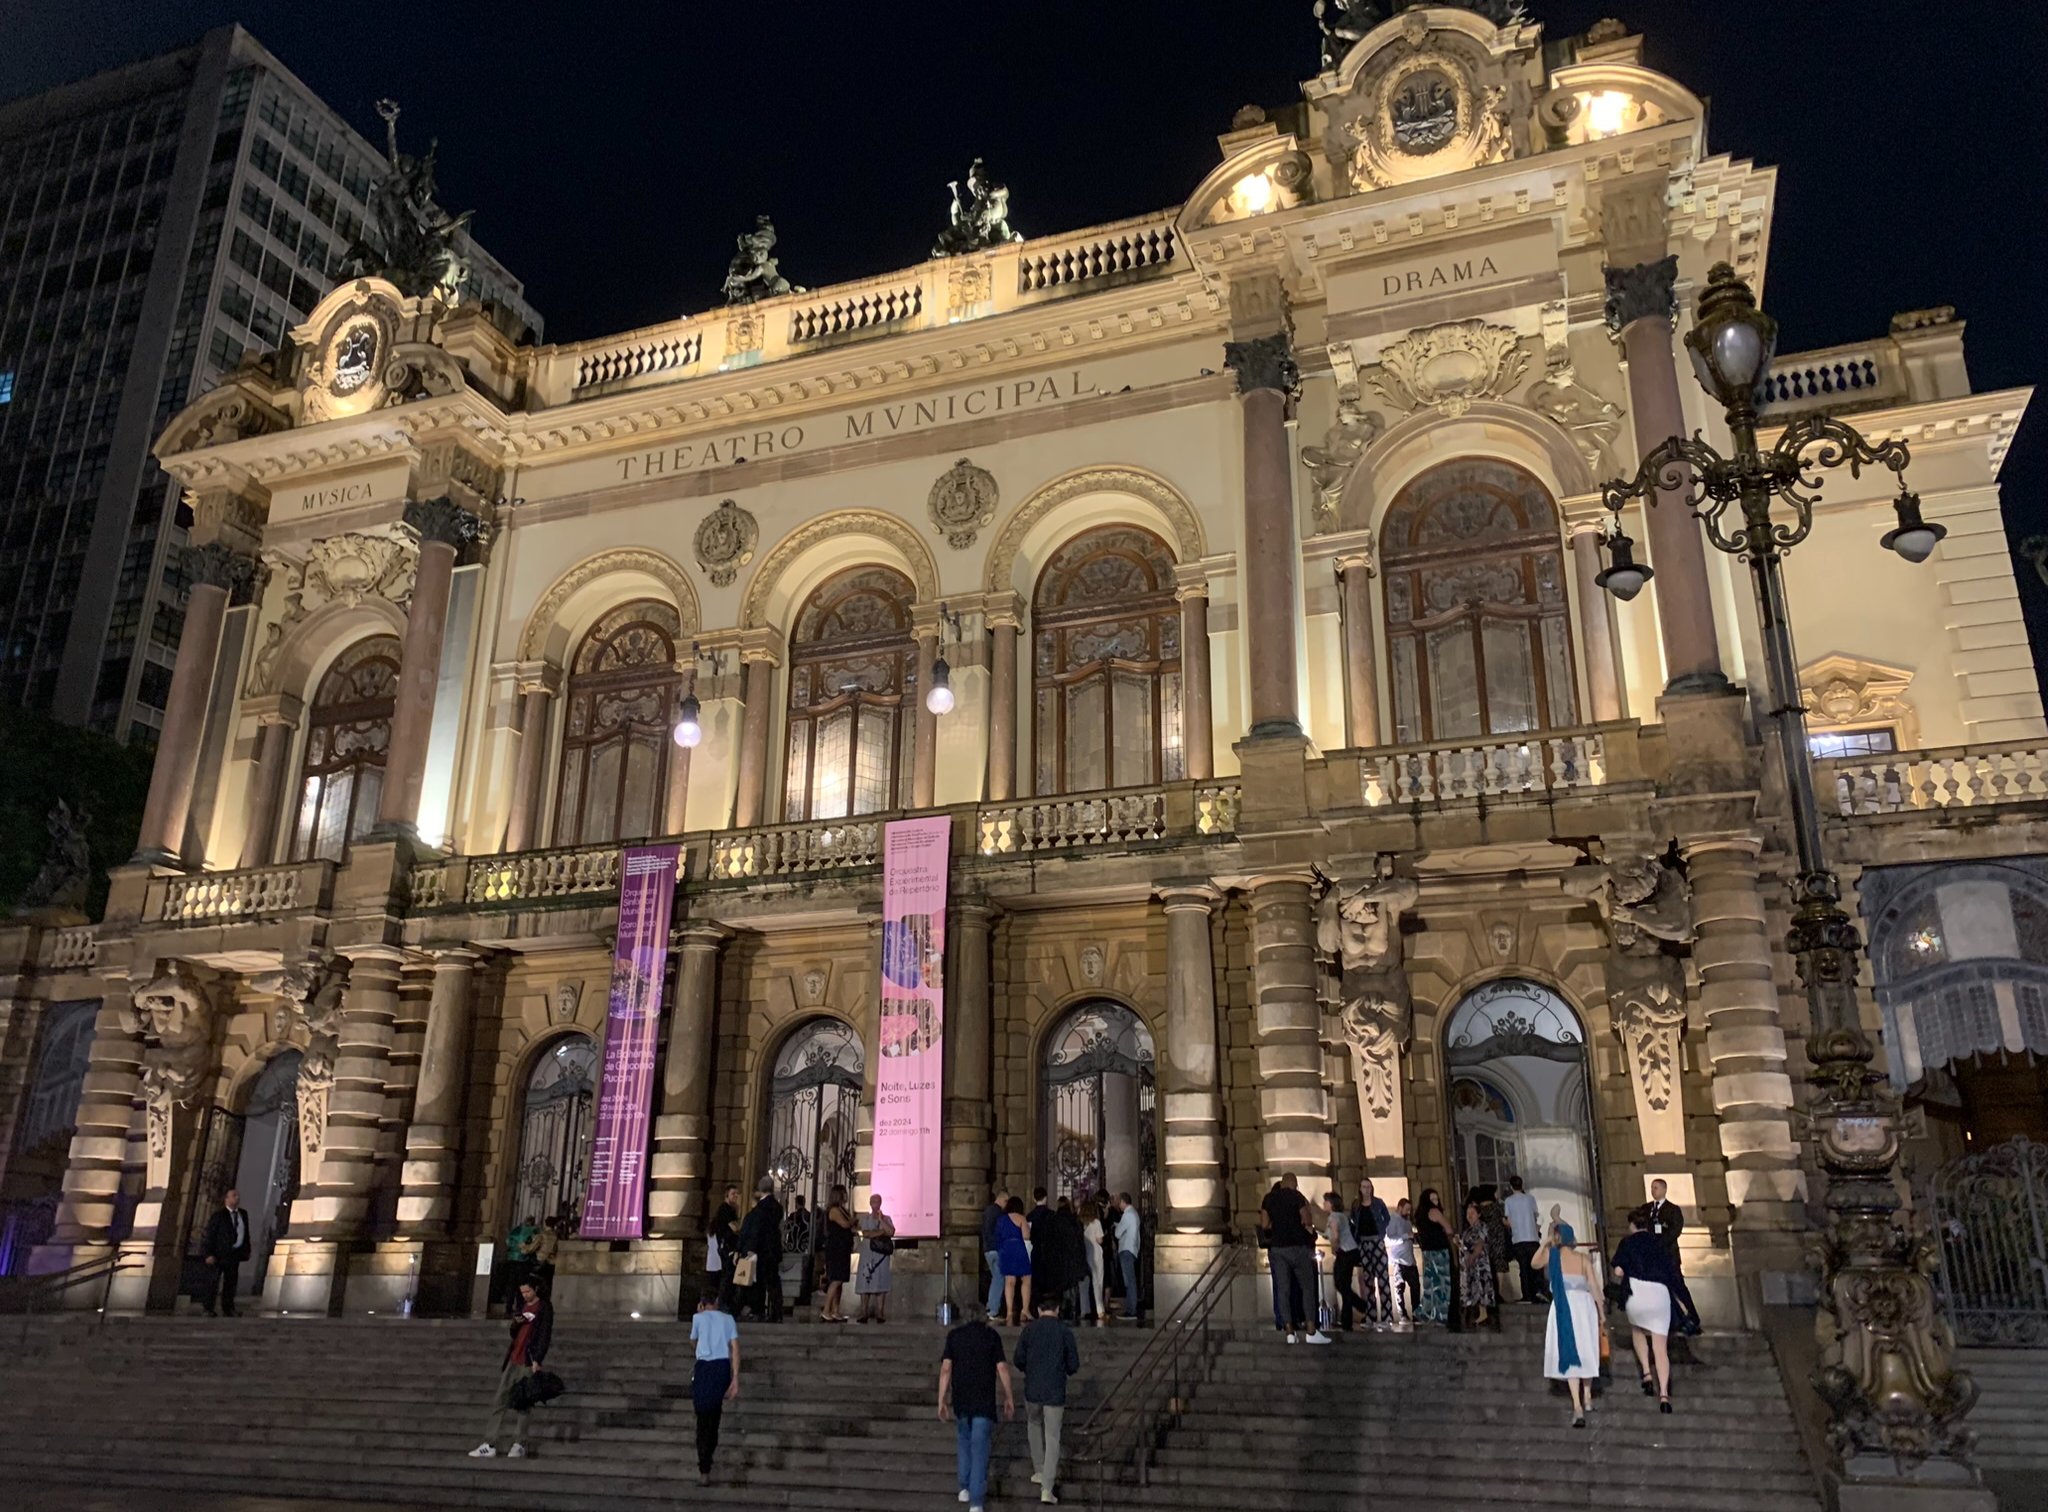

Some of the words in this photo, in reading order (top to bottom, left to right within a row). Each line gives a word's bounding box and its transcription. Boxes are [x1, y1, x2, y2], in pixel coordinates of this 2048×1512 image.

[1383, 257, 1498, 296] DRAMA
[616, 426, 804, 480] THEATRO
[846, 370, 1096, 439] MVNICIPAL
[302, 483, 372, 511] MVSICA
[605, 1049, 616, 1060] La
[881, 1081, 907, 1092] Noite,
[909, 1080, 936, 1091] Luzes
[880, 1096, 886, 1104] e
[887, 1093, 911, 1104] Sons
[879, 1128, 887, 1136] 22
